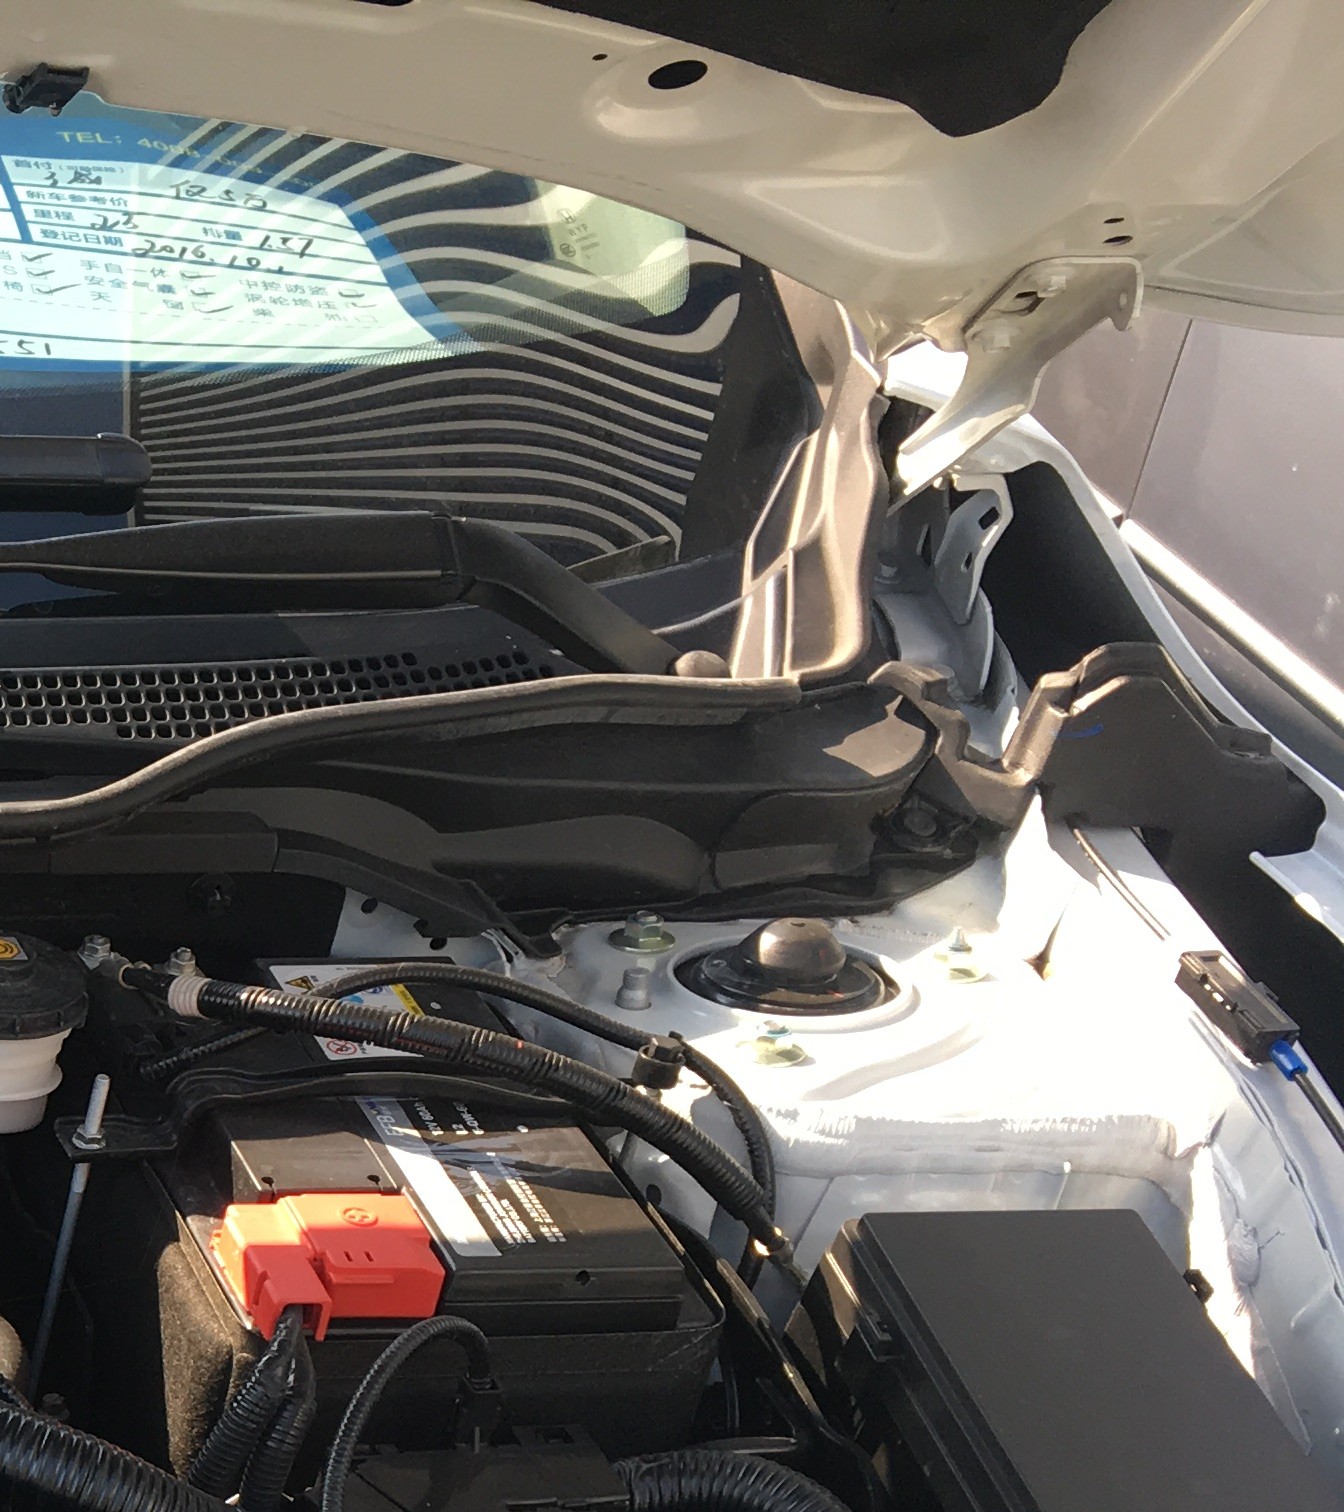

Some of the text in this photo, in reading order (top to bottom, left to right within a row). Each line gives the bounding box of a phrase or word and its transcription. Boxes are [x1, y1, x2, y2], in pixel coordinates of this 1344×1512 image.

[25, 189, 128, 207] 新车参考价
[33, 208, 75, 222] 里程
[40, 228, 124, 248] 登记日期
[202, 226, 243, 242] 排量
